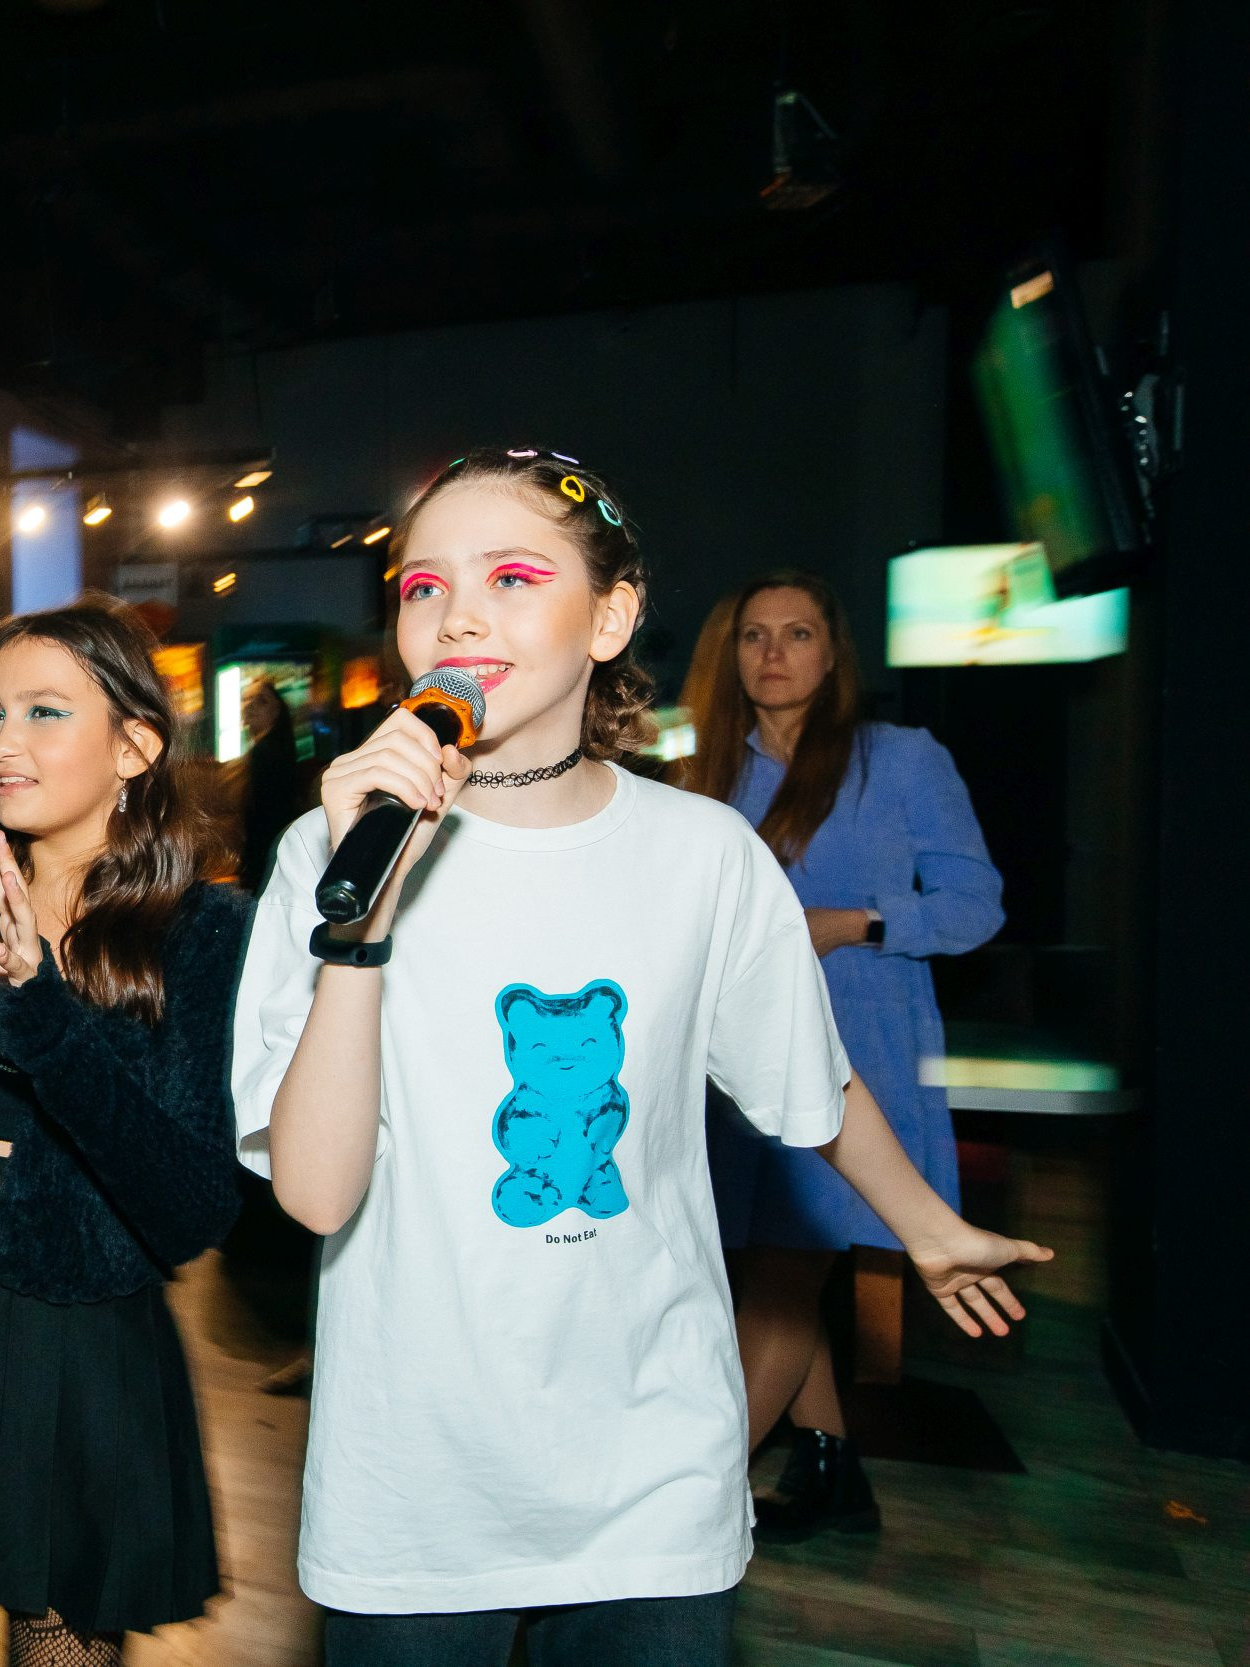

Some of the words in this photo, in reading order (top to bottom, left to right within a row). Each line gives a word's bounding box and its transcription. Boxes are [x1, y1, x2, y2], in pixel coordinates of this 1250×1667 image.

[546, 1234, 560, 1244] Do
[563, 1233, 582, 1244] Not
[583, 1228, 597, 1241] Eat
